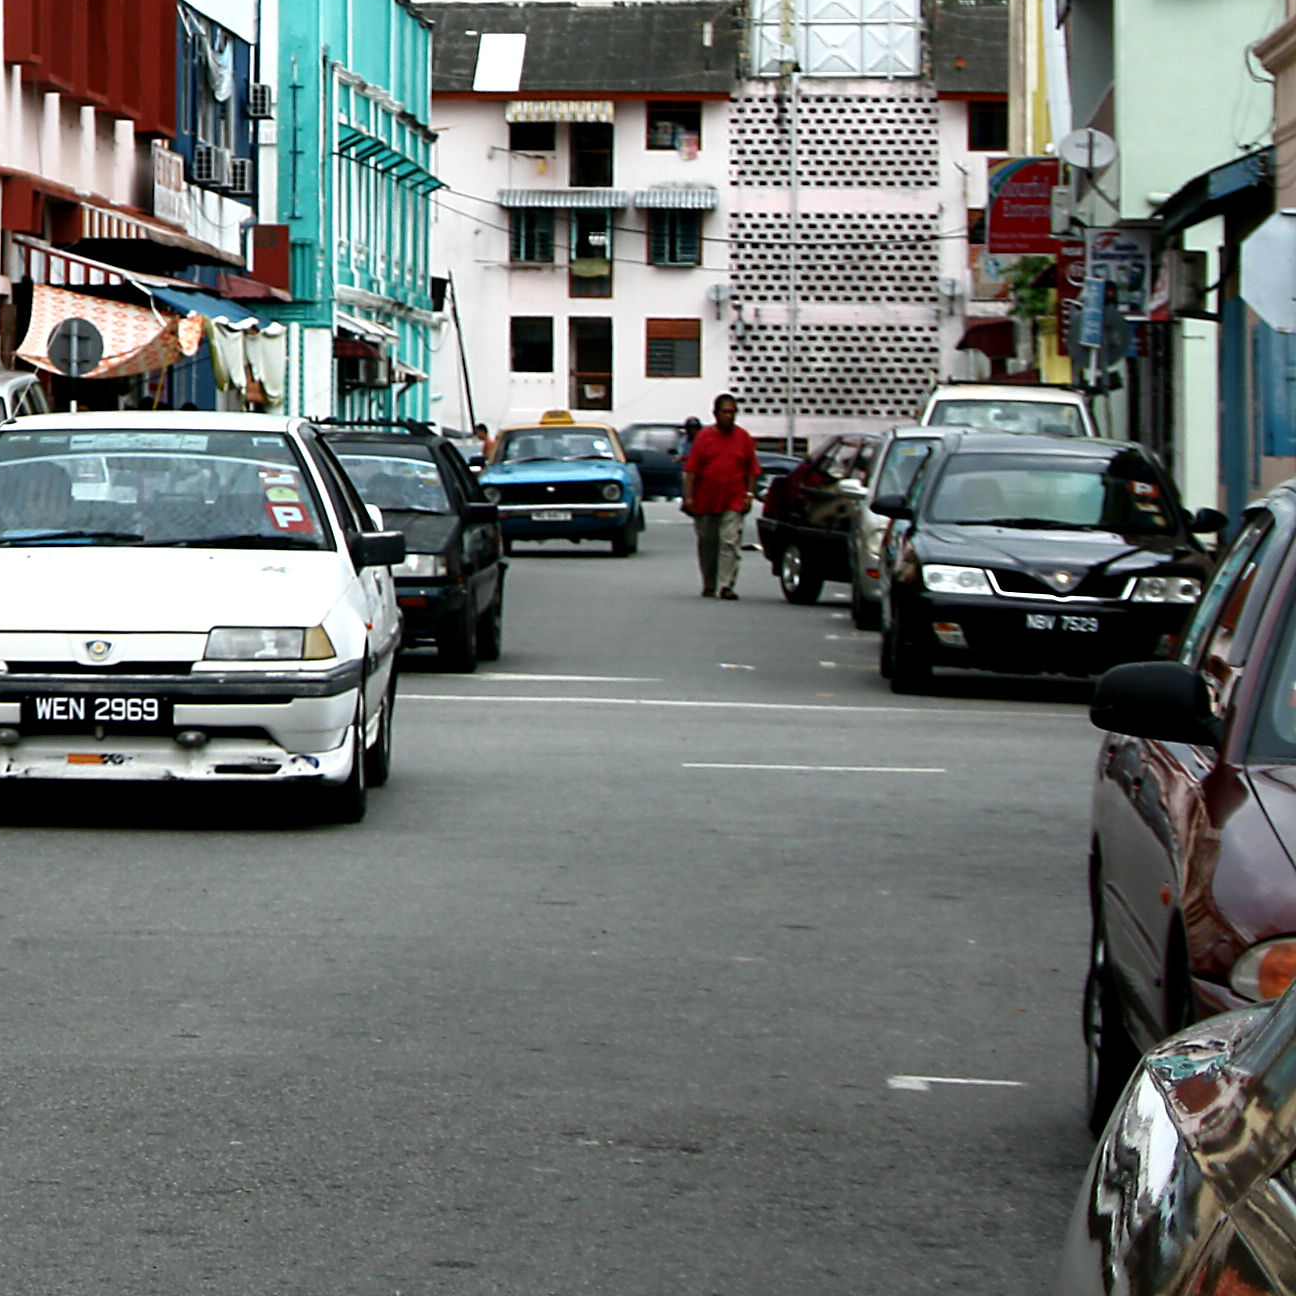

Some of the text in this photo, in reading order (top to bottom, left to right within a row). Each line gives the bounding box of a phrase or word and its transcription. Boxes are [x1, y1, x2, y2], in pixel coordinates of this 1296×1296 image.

[271, 506, 304, 528] P
[36, 697, 159, 721] WEN 2969
